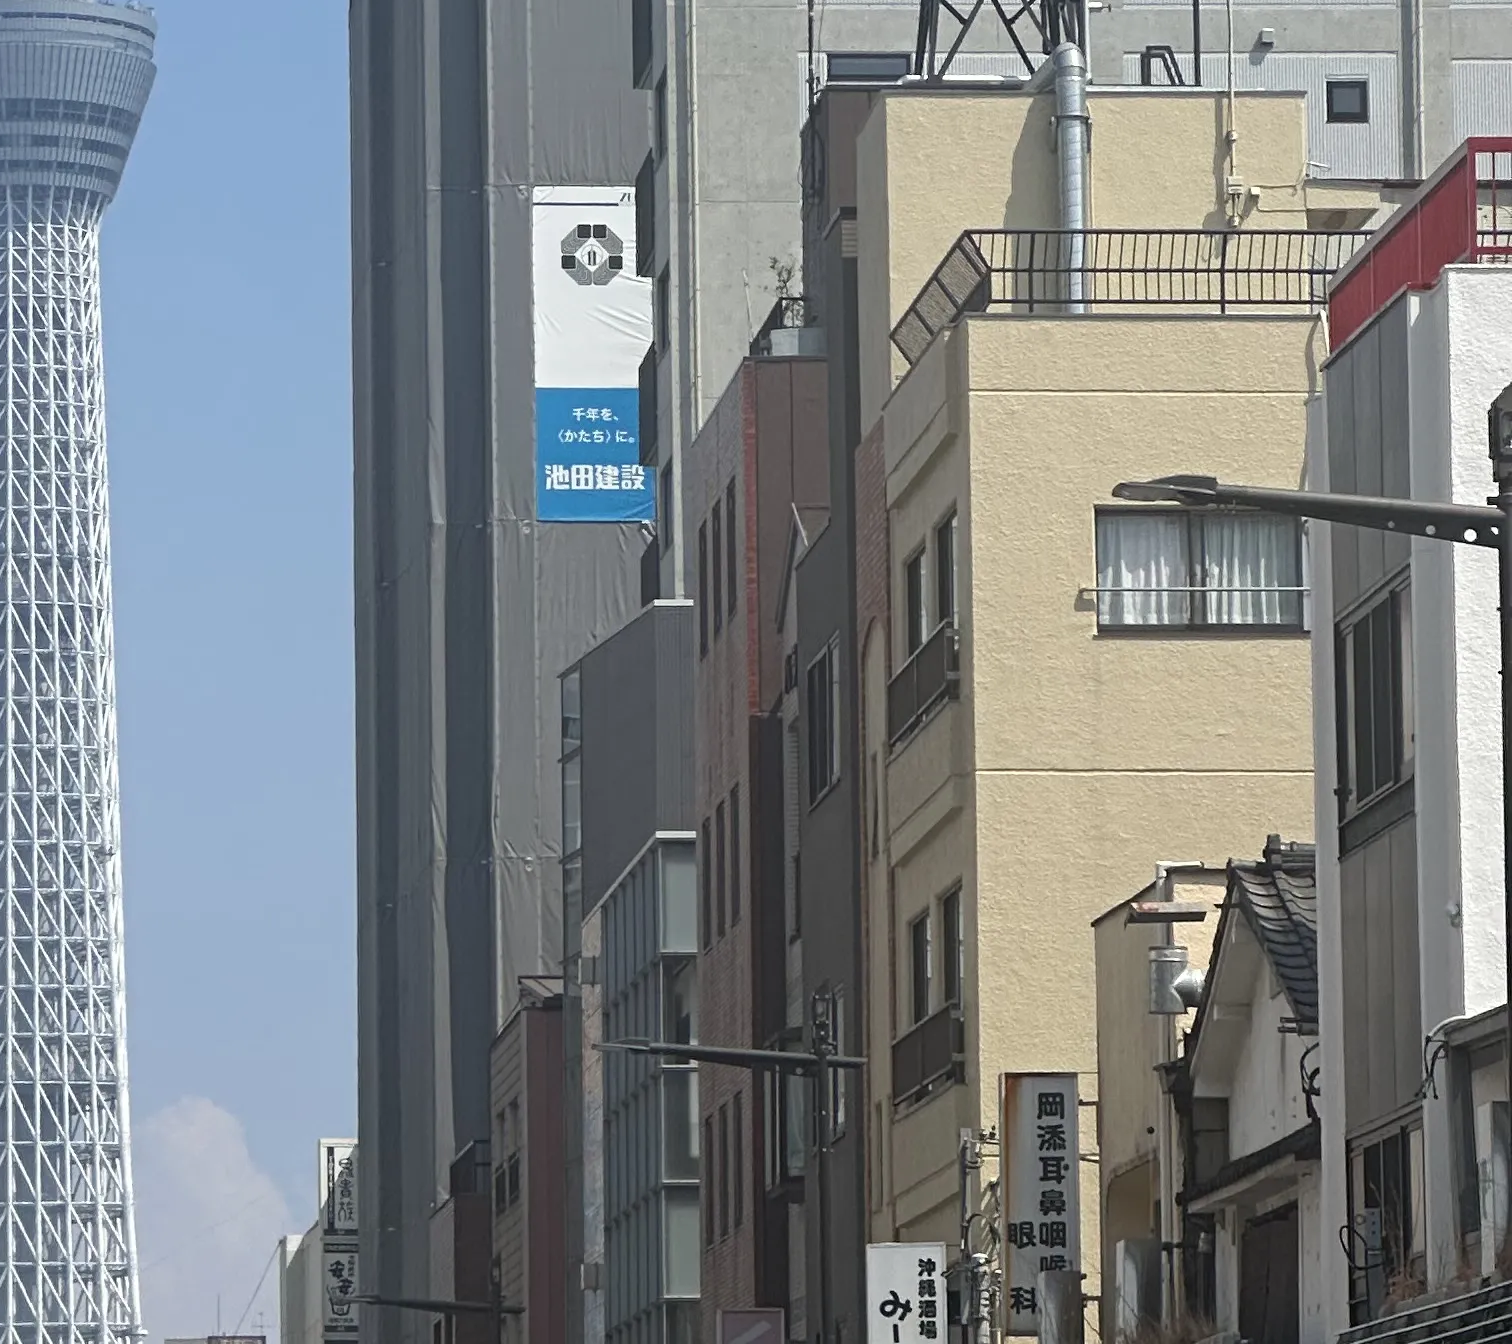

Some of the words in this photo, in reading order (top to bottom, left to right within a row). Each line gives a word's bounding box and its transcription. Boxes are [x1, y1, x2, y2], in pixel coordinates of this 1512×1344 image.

[572, 407, 619, 422] 千年を、
[544, 464, 646, 491] 池田建設
[918, 1258, 938, 1340] 沖縄酒場
